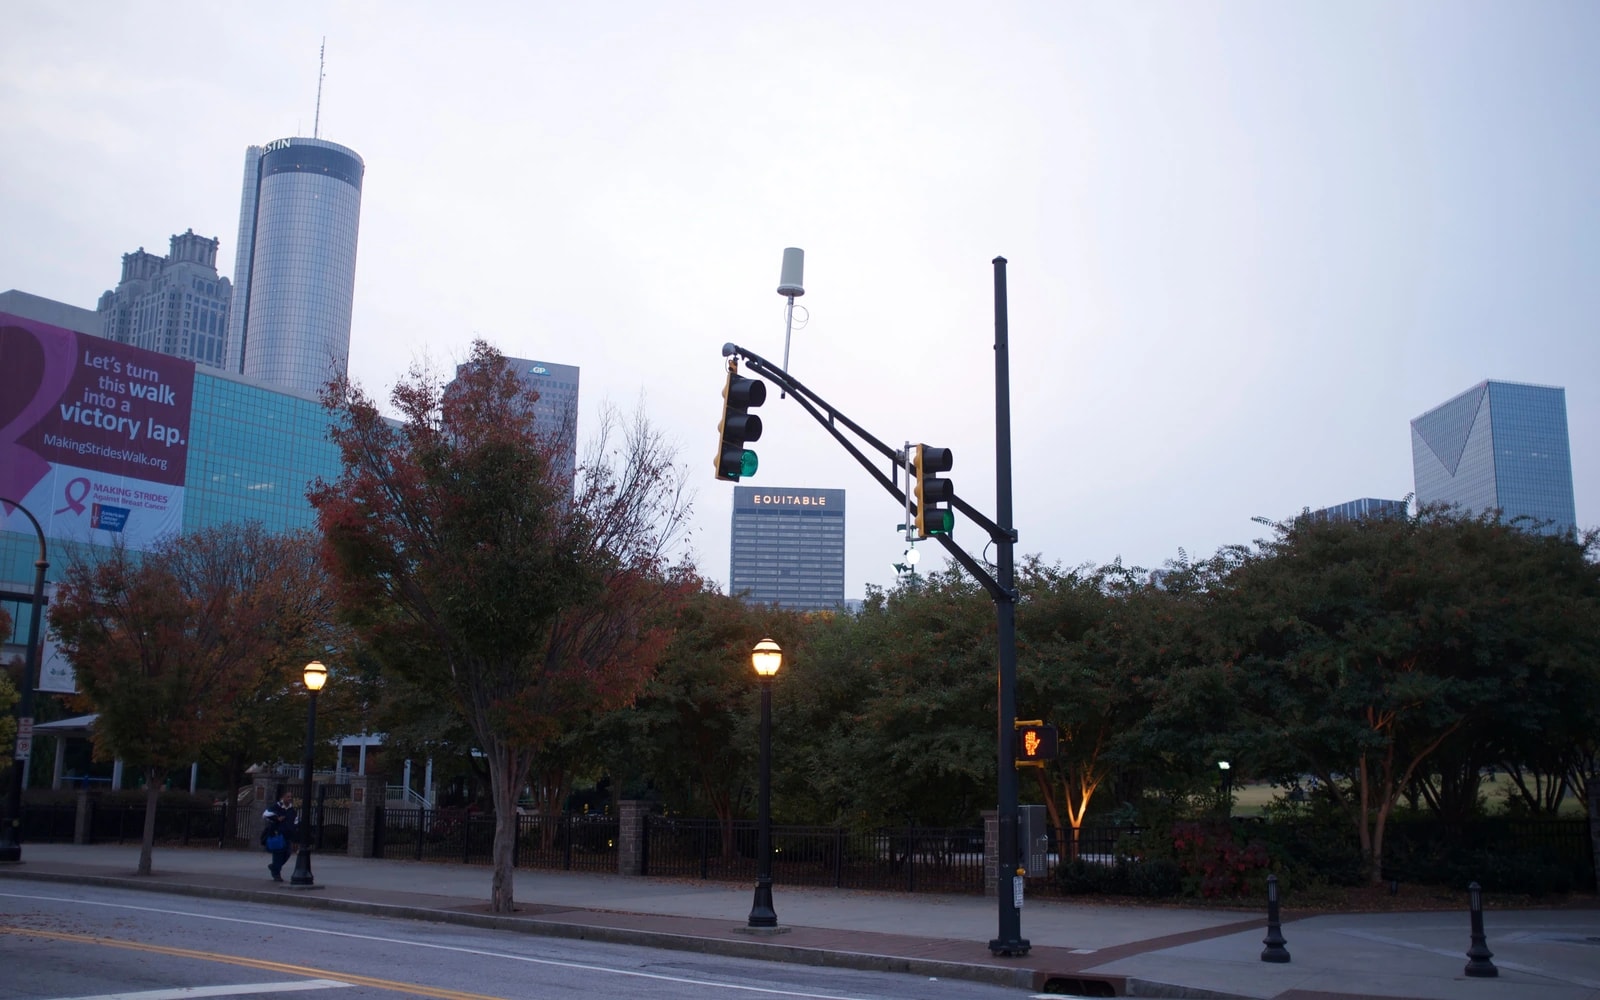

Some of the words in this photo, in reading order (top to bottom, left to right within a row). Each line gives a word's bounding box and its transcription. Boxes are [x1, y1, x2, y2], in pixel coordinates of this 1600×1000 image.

[84, 351, 121, 374] Let's
[126, 362, 159, 382] turn
[84, 388, 116, 409] into
[120, 400, 131, 413] a
[98, 375, 126, 394] this
[129, 381, 176, 406] walk
[60, 402, 141, 440] victory
[147, 418, 186, 448] lap.
[43, 433, 168, 470] MakingStridesWalk.org
[93, 483, 132, 498] MAKING
[133, 490, 168, 504] STRIDES
[93, 493, 120, 503] Against
[121, 498, 143, 507] Breast
[144, 501, 166, 511] Cancer
[753, 495, 826, 506] EQUITABLE
